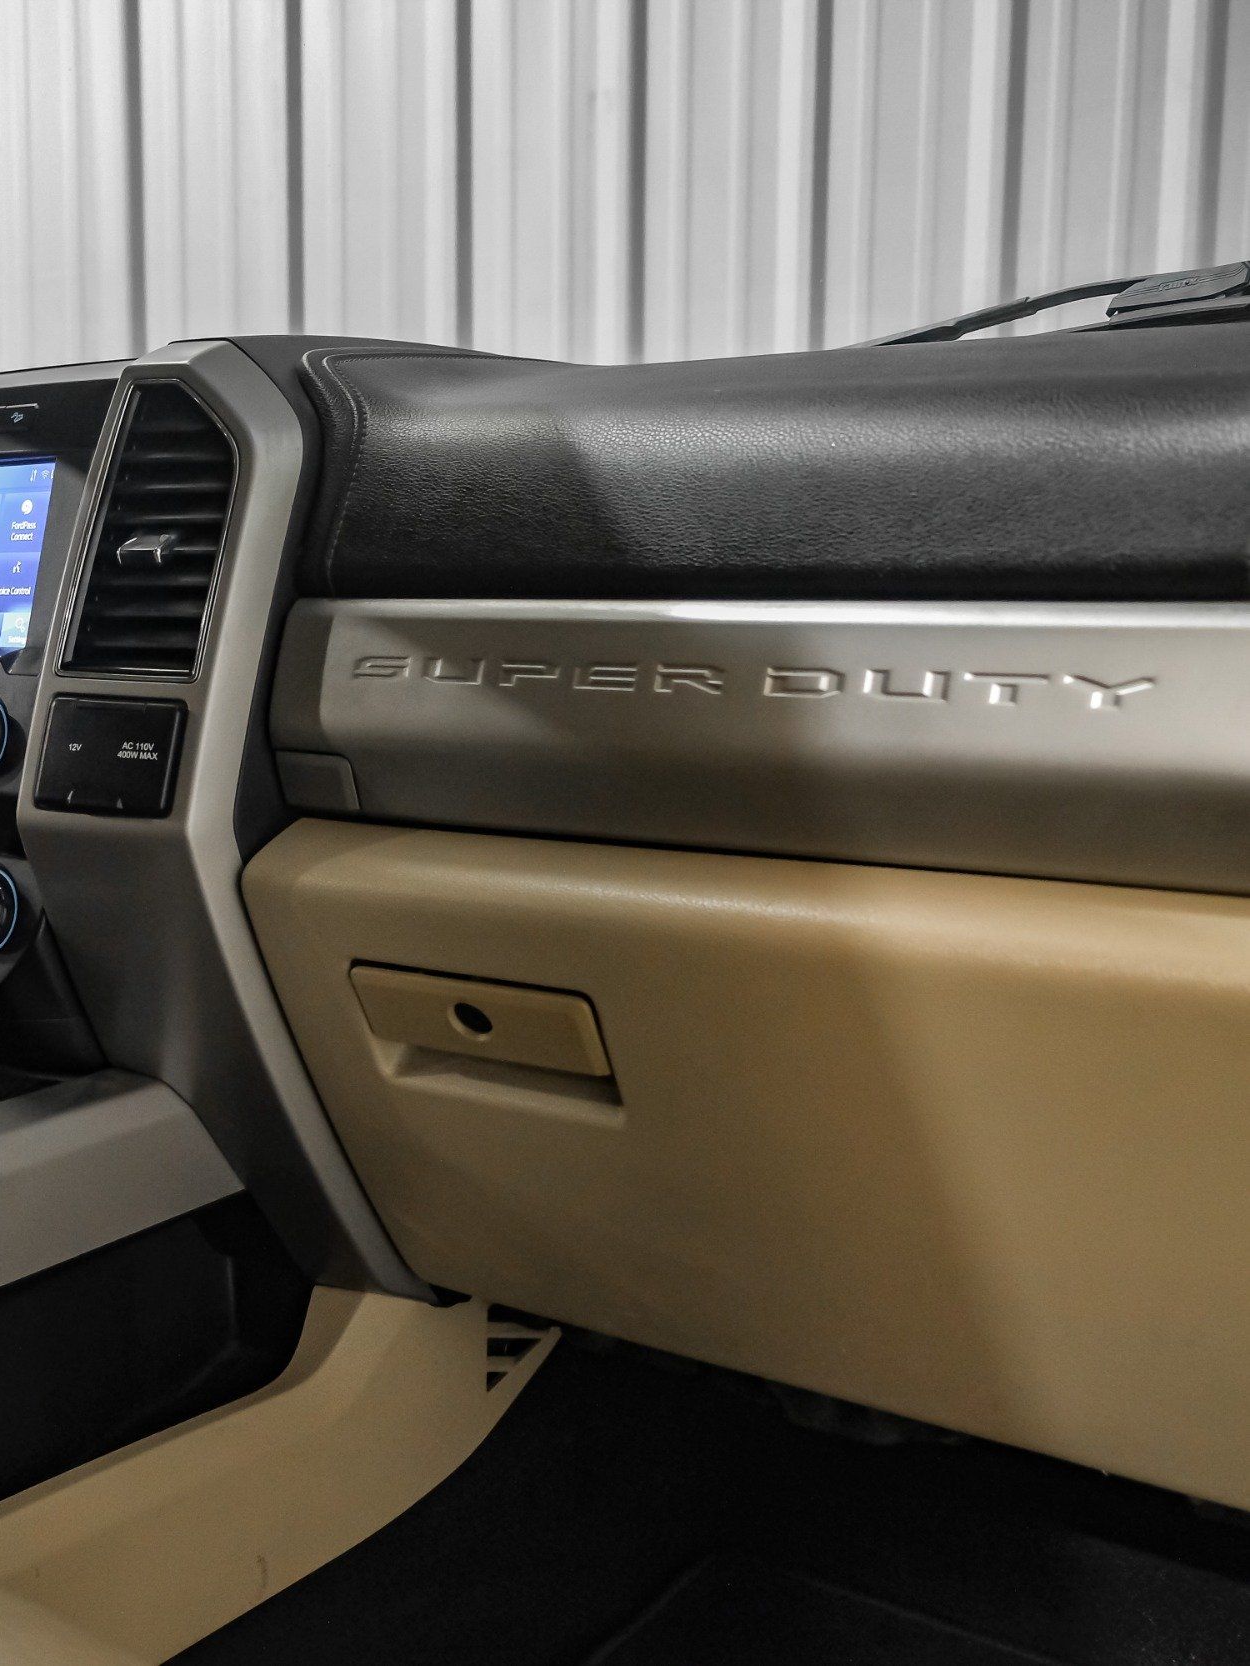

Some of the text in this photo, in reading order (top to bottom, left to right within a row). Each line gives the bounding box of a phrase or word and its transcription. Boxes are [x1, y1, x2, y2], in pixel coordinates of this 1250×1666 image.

[11, 521, 37, 530] FordPass
[10, 532, 34, 542] Connect
[10, 586, 32, 596] Control
[353, 656, 1156, 712] SUPER DUTY
[68, 743, 83, 751] 12V
[122, 741, 155, 751] AC 110V
[117, 750, 158, 760] 400W MAX
